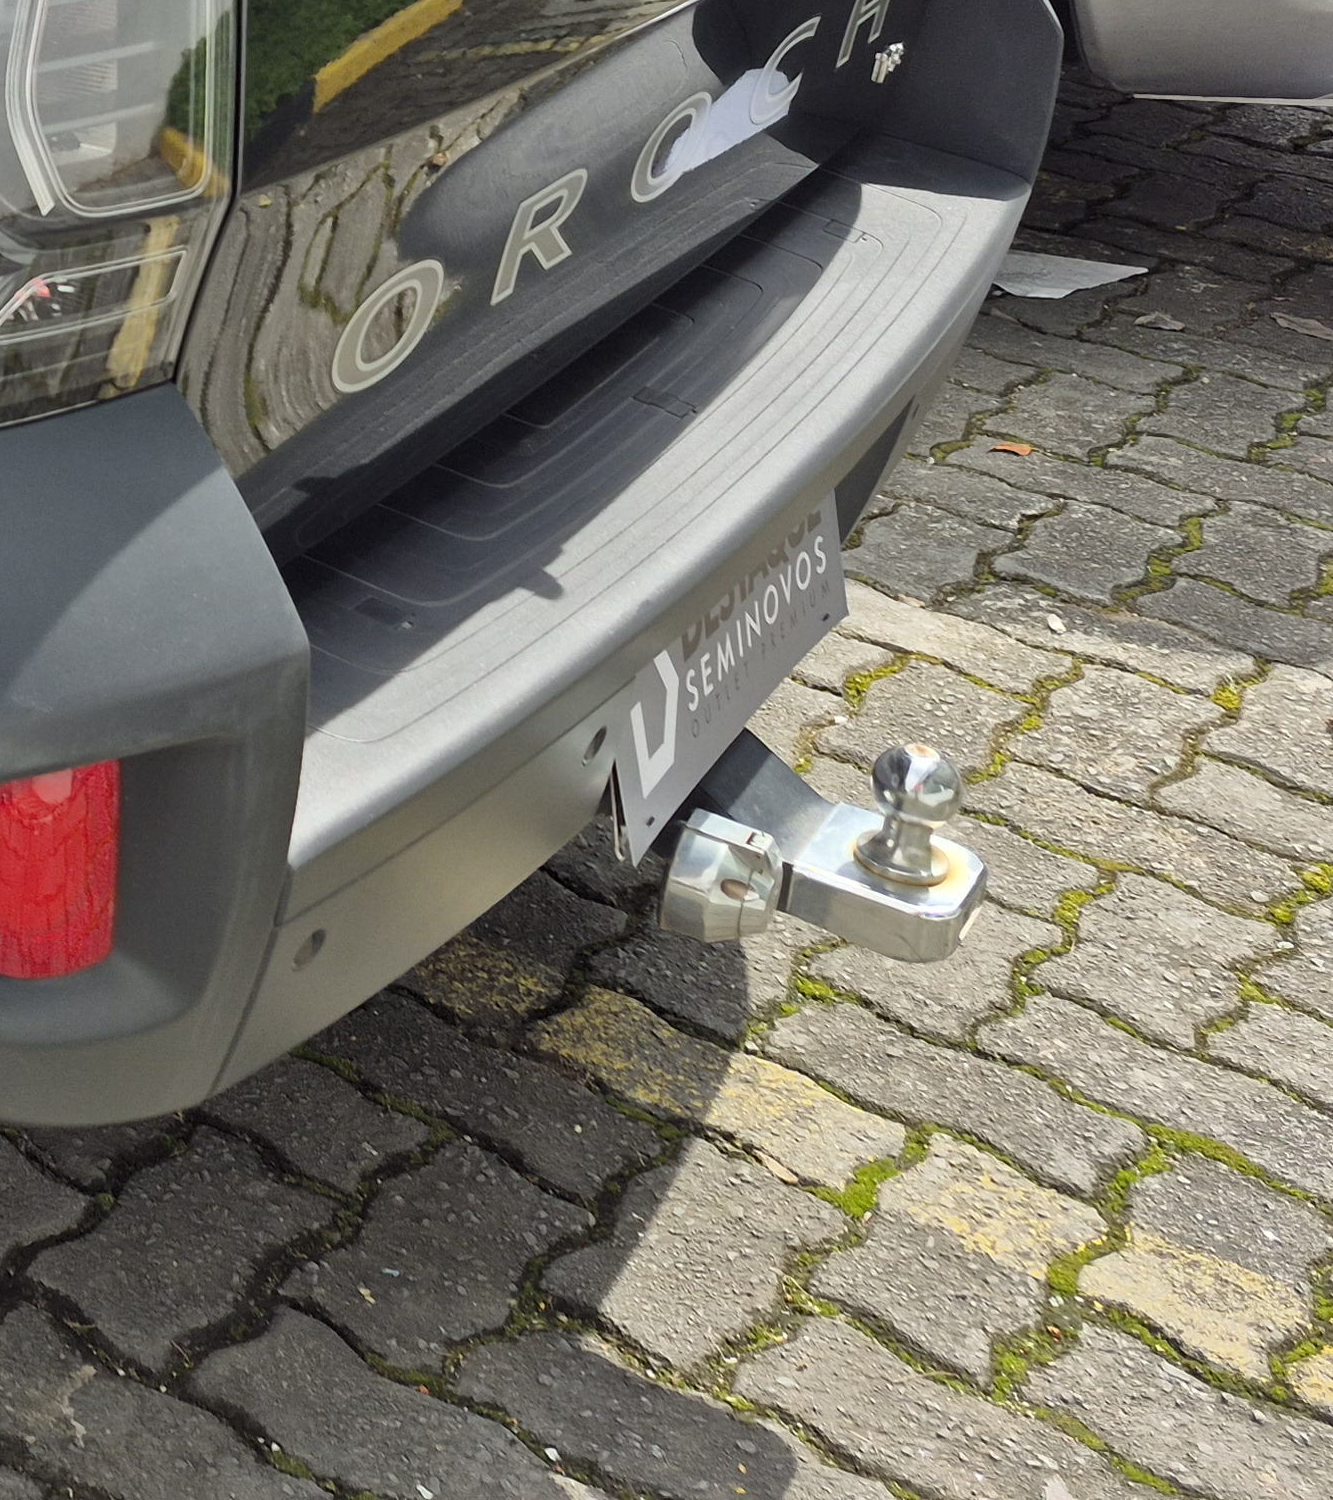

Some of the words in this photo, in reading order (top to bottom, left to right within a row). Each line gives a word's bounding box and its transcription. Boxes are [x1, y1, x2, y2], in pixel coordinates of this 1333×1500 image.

[685, 535, 827, 712] SEMINOVOS
[689, 658, 750, 739] OUTLET
[760, 583, 831, 658] PREMIUM
